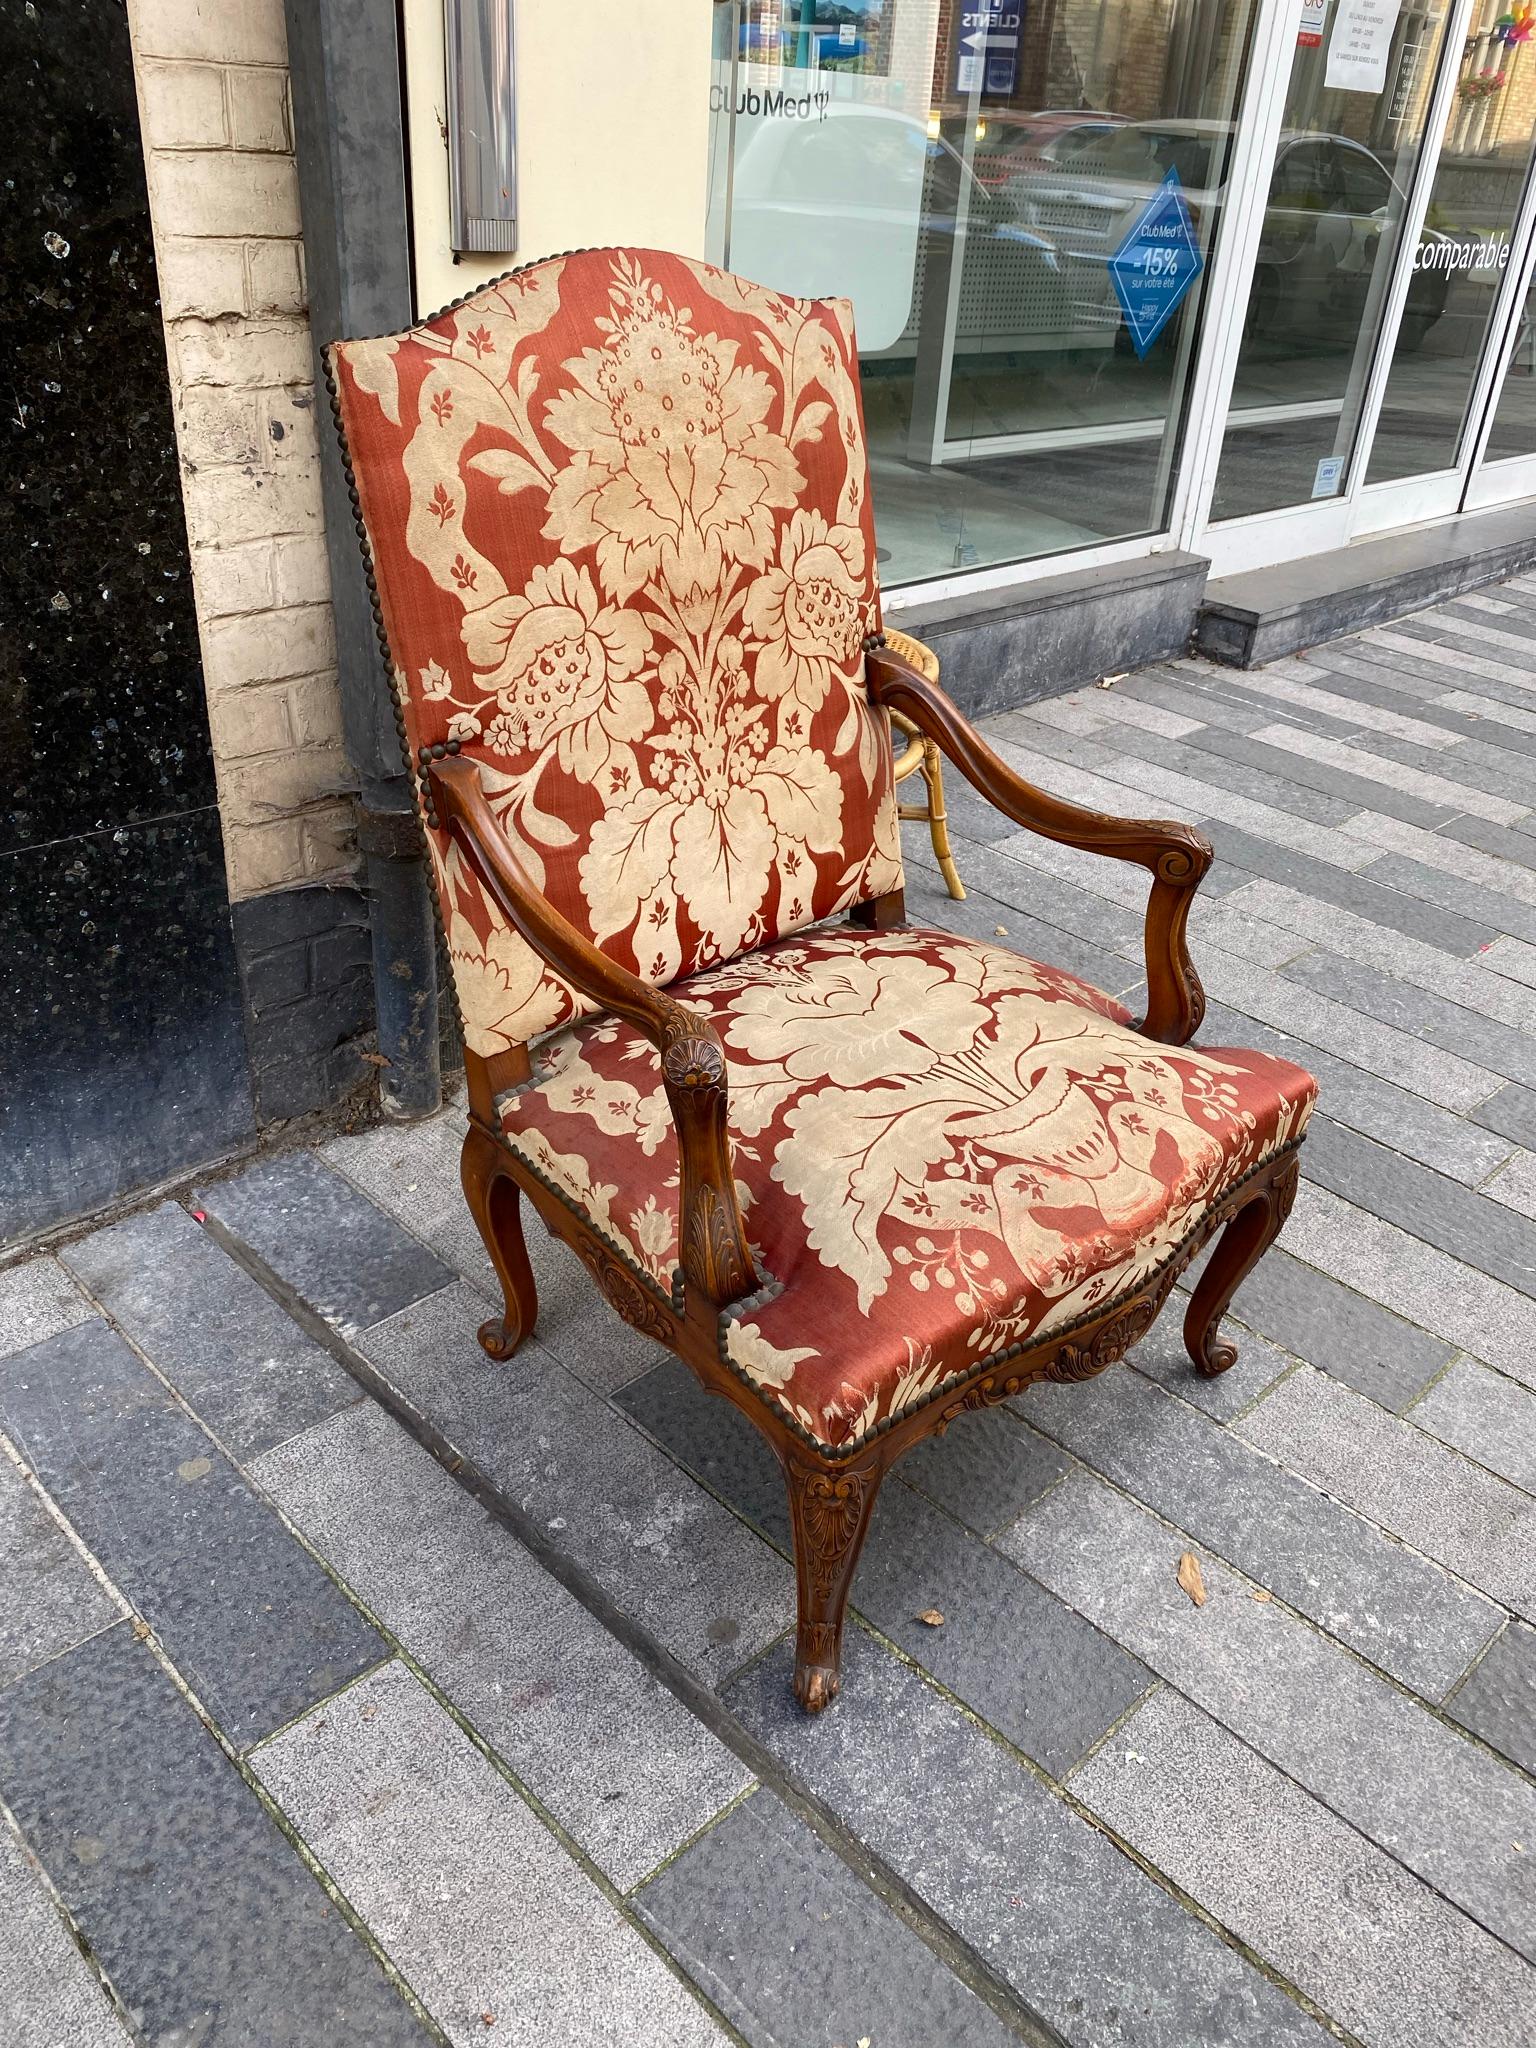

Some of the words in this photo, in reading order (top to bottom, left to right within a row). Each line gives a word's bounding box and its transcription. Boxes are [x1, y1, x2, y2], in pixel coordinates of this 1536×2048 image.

[709, 85, 760, 116] Club
[763, 89, 811, 120] Med
[1141, 224, 1159, 238] Club
[1159, 225, 1177, 238] Med
[1133, 247, 1179, 276] -15%
[1413, 232, 1510, 281] comparable
[1131, 279, 1143, 289] sur
[1144, 277, 1162, 289] votre
[1162, 277, 1175, 289] été
